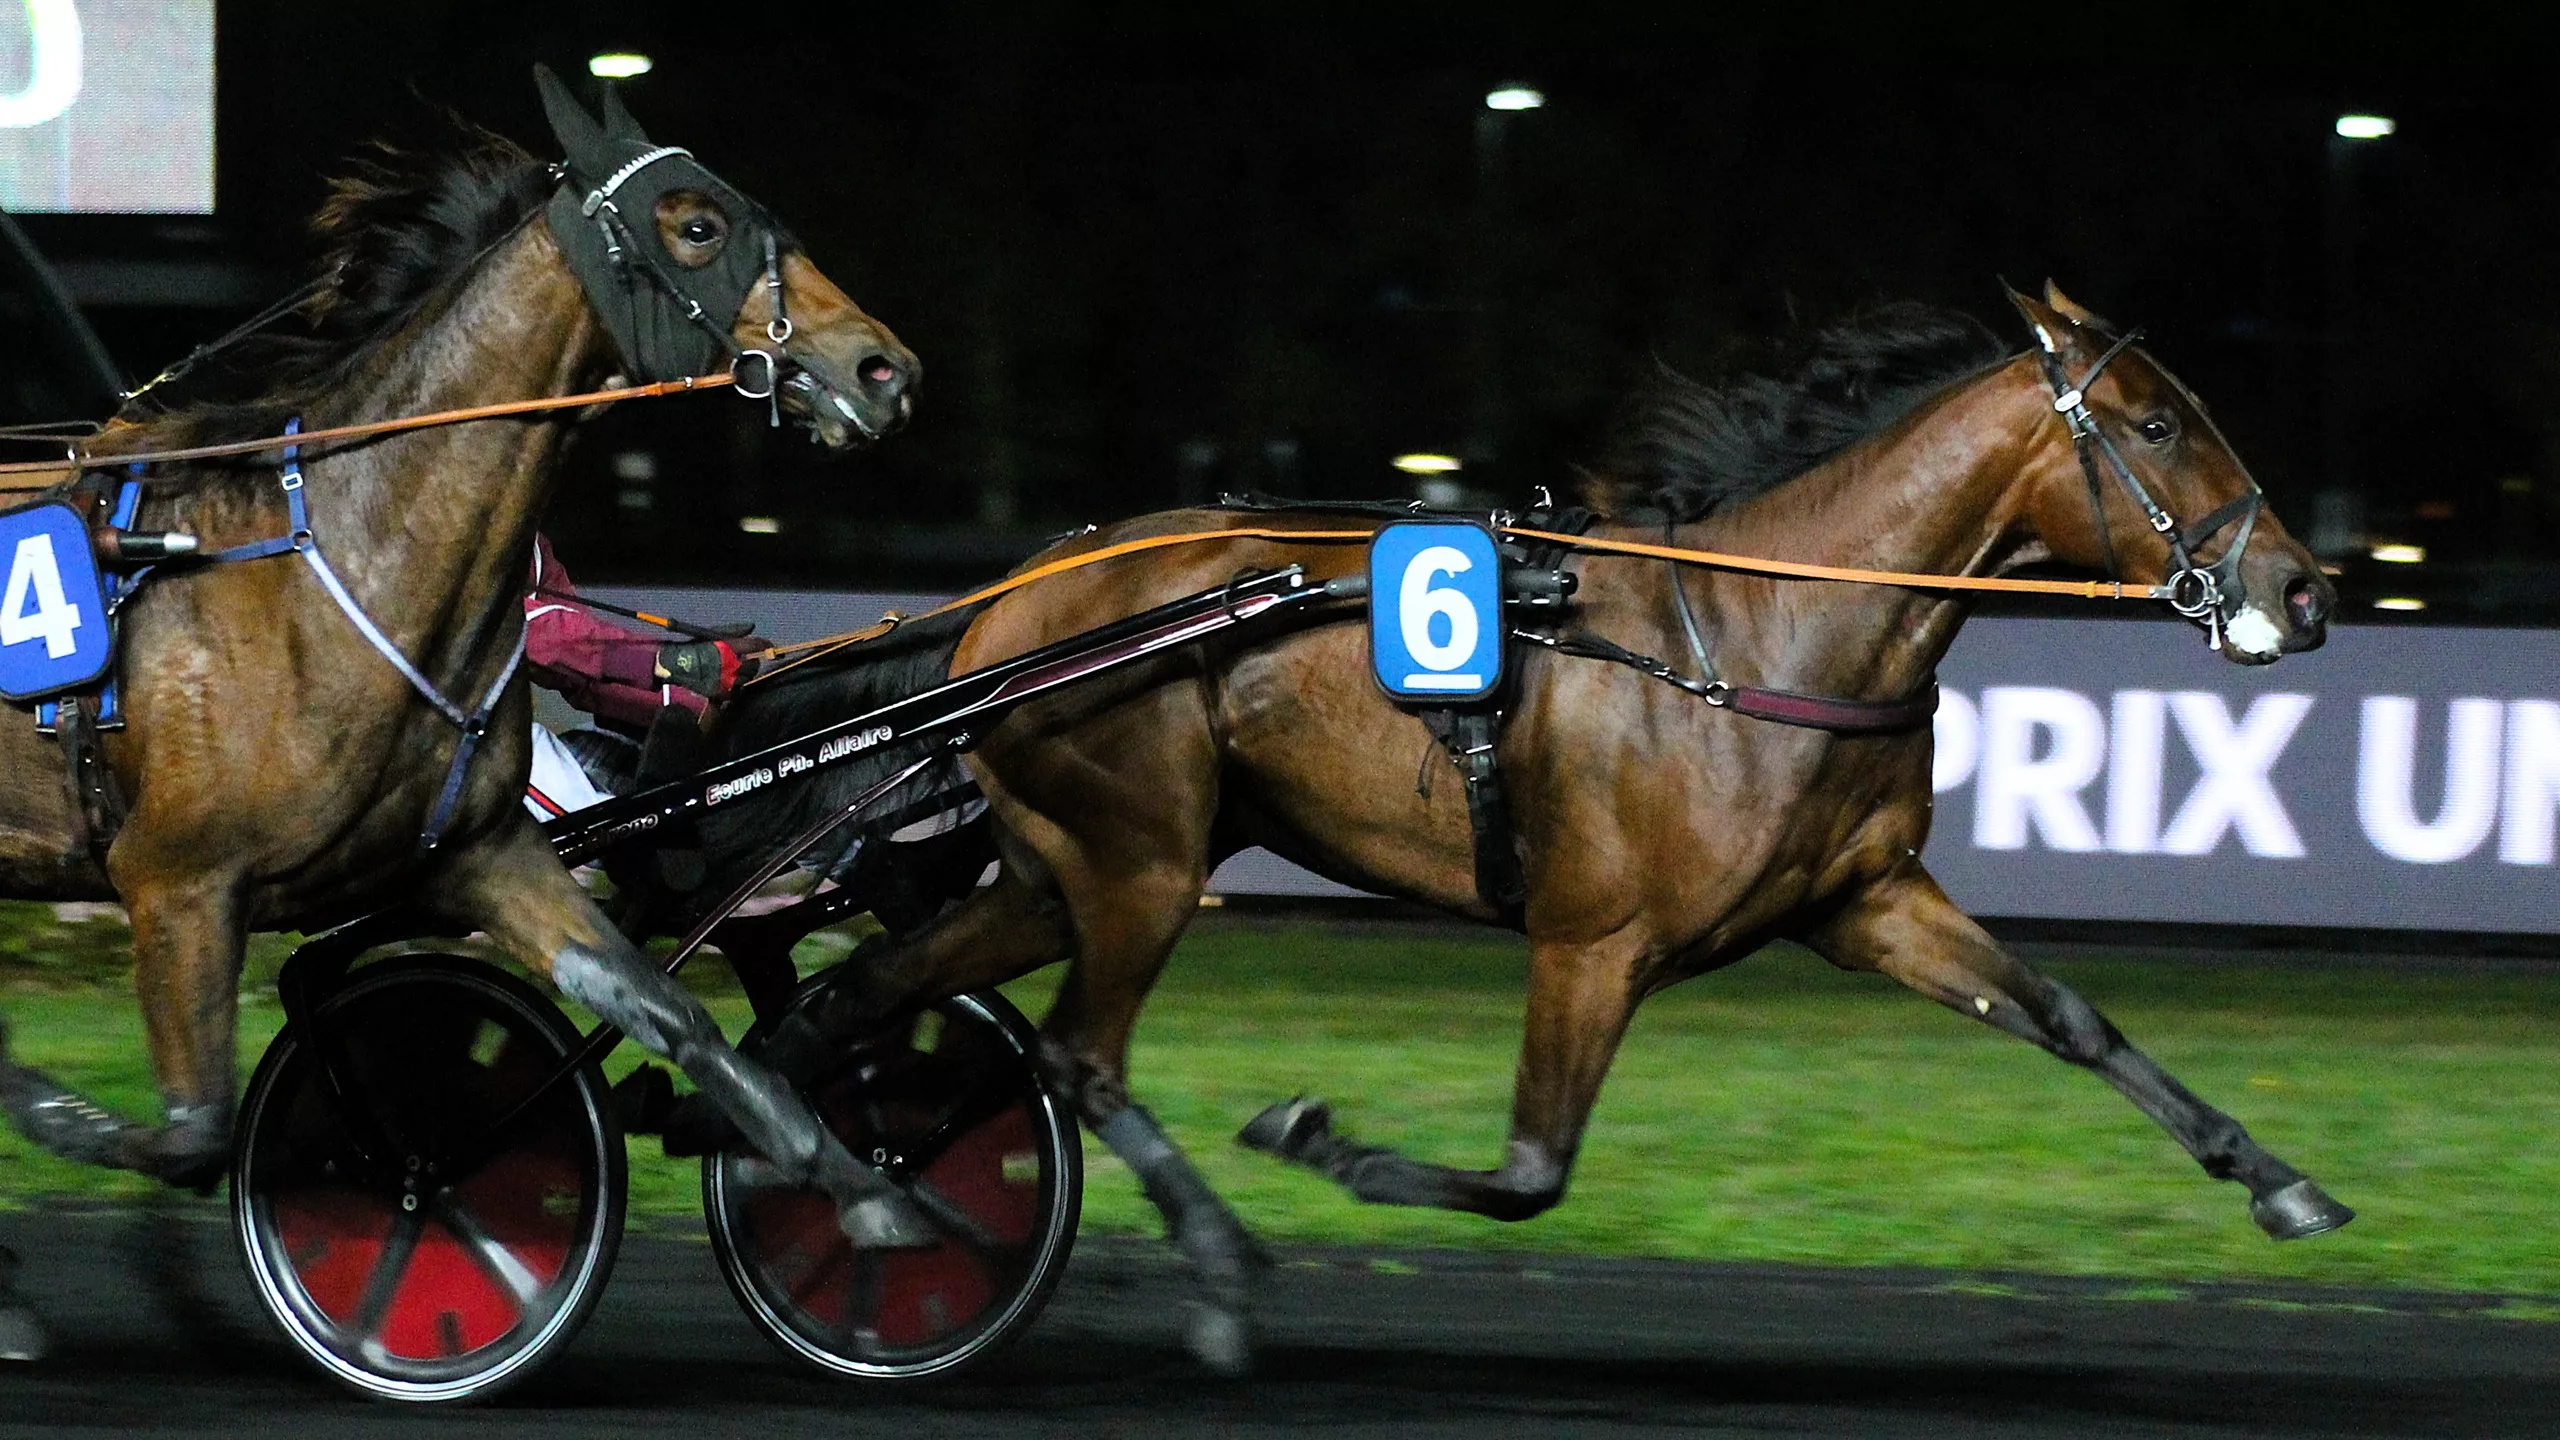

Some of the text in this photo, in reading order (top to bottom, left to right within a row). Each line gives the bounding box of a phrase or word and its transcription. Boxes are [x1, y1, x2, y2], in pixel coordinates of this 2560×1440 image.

[0, 533, 82, 660] 4
[1399, 546, 1479, 672] 6
[705, 724, 893, 806] Ecurie Ph. Allaire
